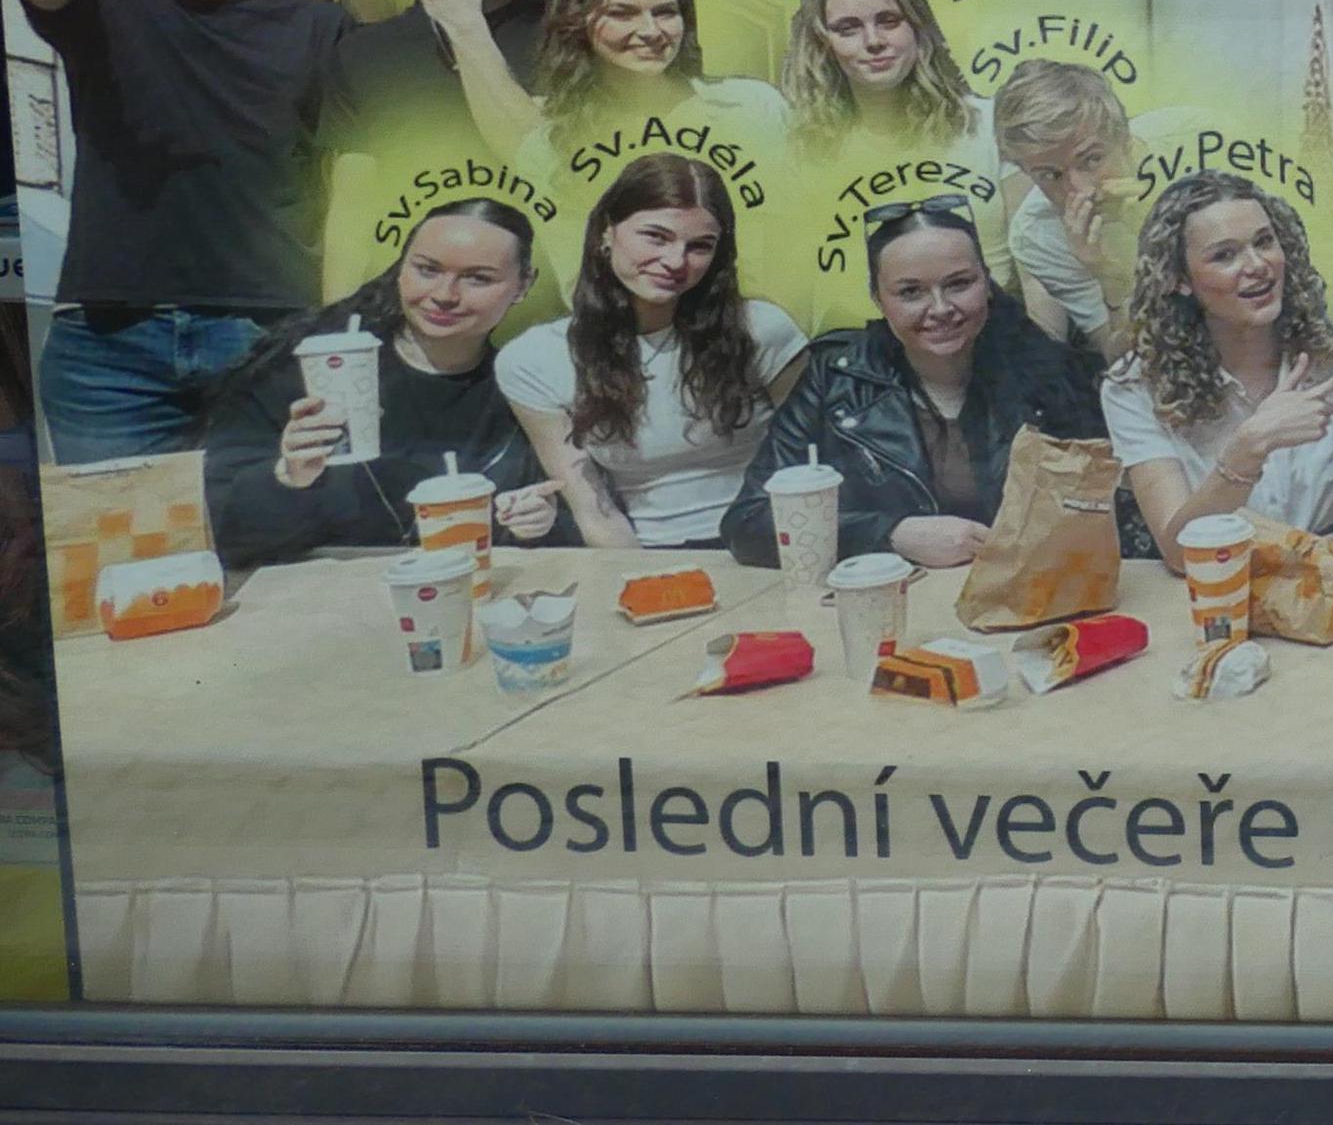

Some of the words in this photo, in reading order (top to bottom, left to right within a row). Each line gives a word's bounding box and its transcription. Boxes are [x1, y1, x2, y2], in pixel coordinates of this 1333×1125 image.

[971, 14, 1138, 85] Sv.Filip
[375, 159, 557, 247] Sv.Sabina
[570, 116, 765, 210] Sv.Adéla
[1135, 131, 1315, 205] Sv.Petra
[818, 160, 996, 272] Sv.Tereza
[420, 756, 897, 860] Poslední
[930, 769, 1300, 871] večeře
